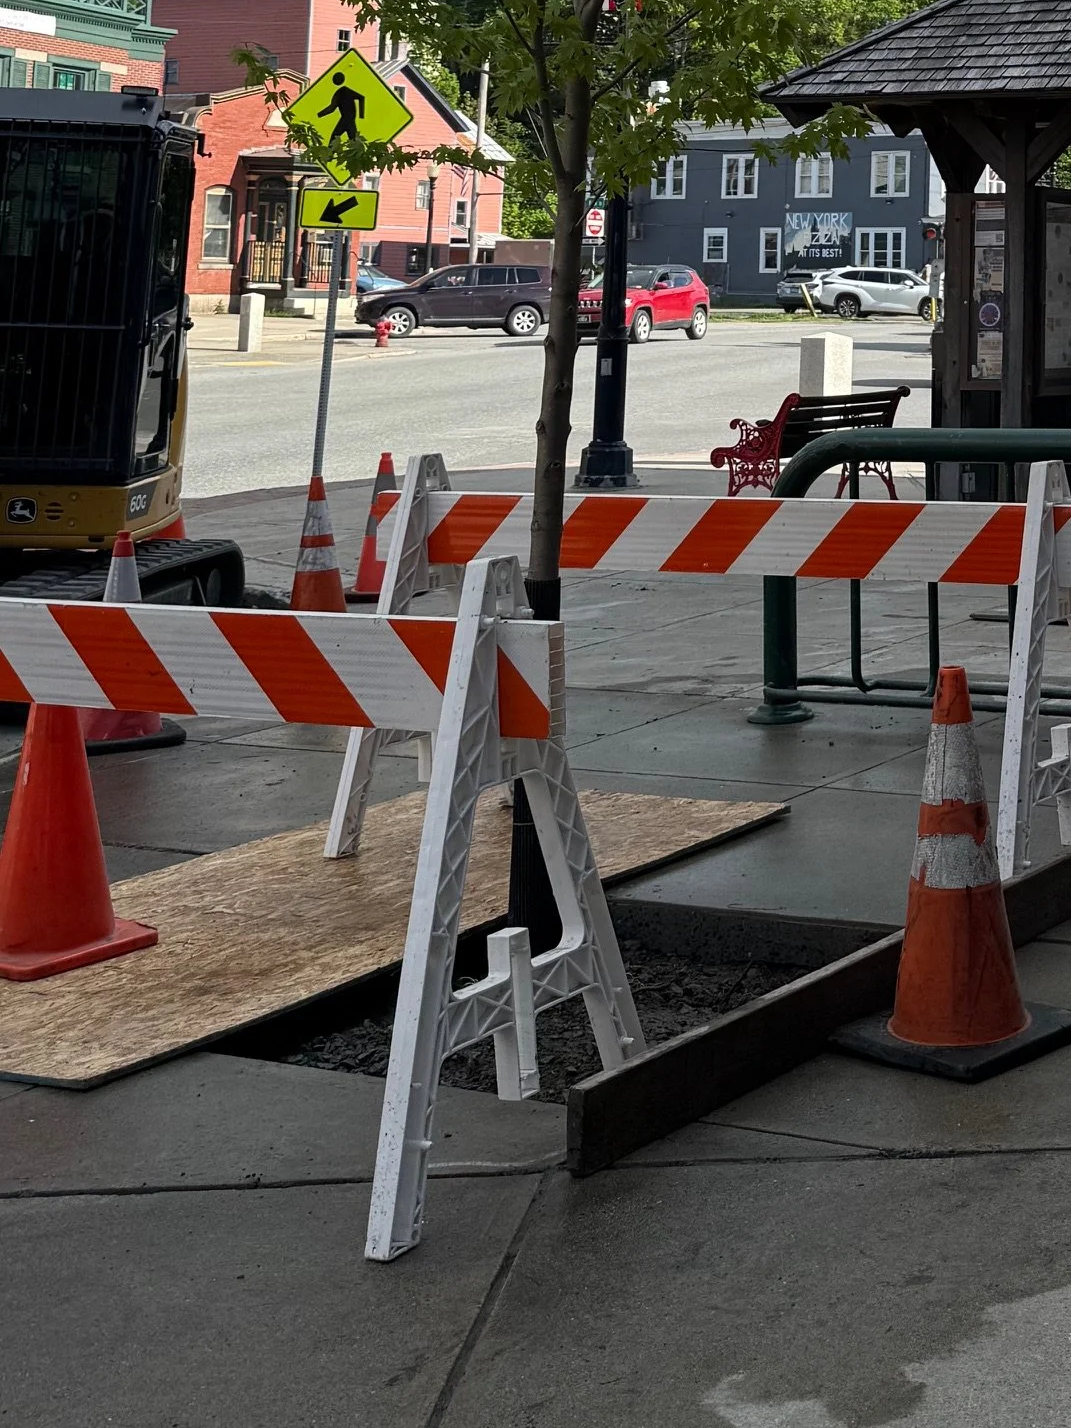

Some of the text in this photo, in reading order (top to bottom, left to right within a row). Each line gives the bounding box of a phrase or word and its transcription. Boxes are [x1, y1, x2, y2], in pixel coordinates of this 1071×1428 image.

[785, 212, 849, 230] NEW YORK
[798, 248, 808, 258] AT
[808, 248, 821, 258] ITS
[130, 494, 147, 513] 60G
